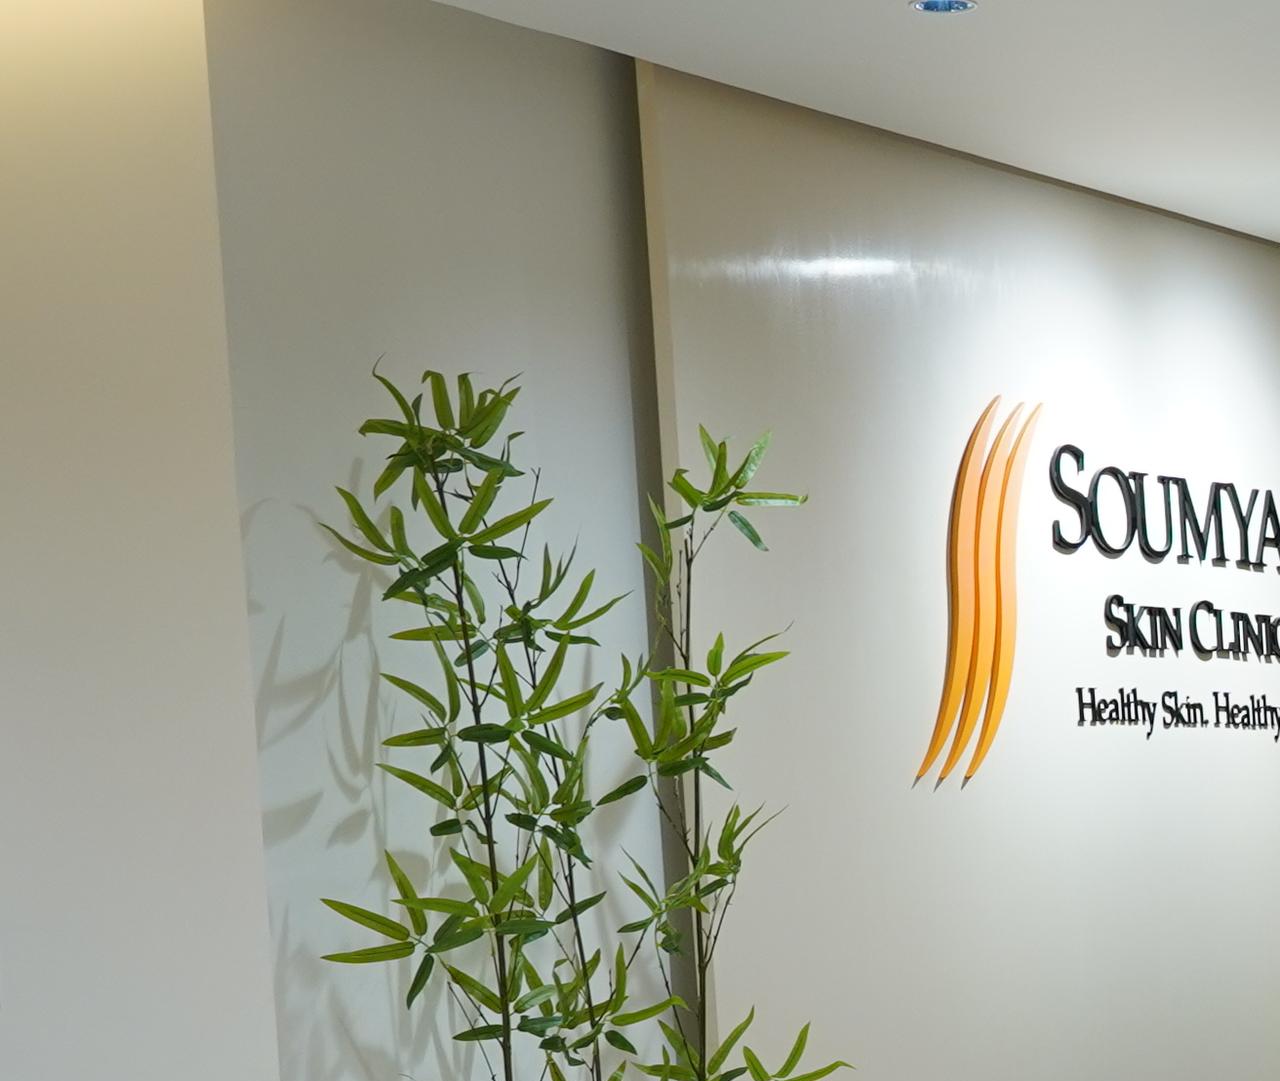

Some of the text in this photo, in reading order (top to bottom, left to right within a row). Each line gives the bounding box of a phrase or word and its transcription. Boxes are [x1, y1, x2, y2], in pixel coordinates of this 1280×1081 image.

[1104, 594, 1184, 657] SKIN
[1076, 687, 1157, 740] Healthy
[1162, 690, 1209, 729] Skin.
